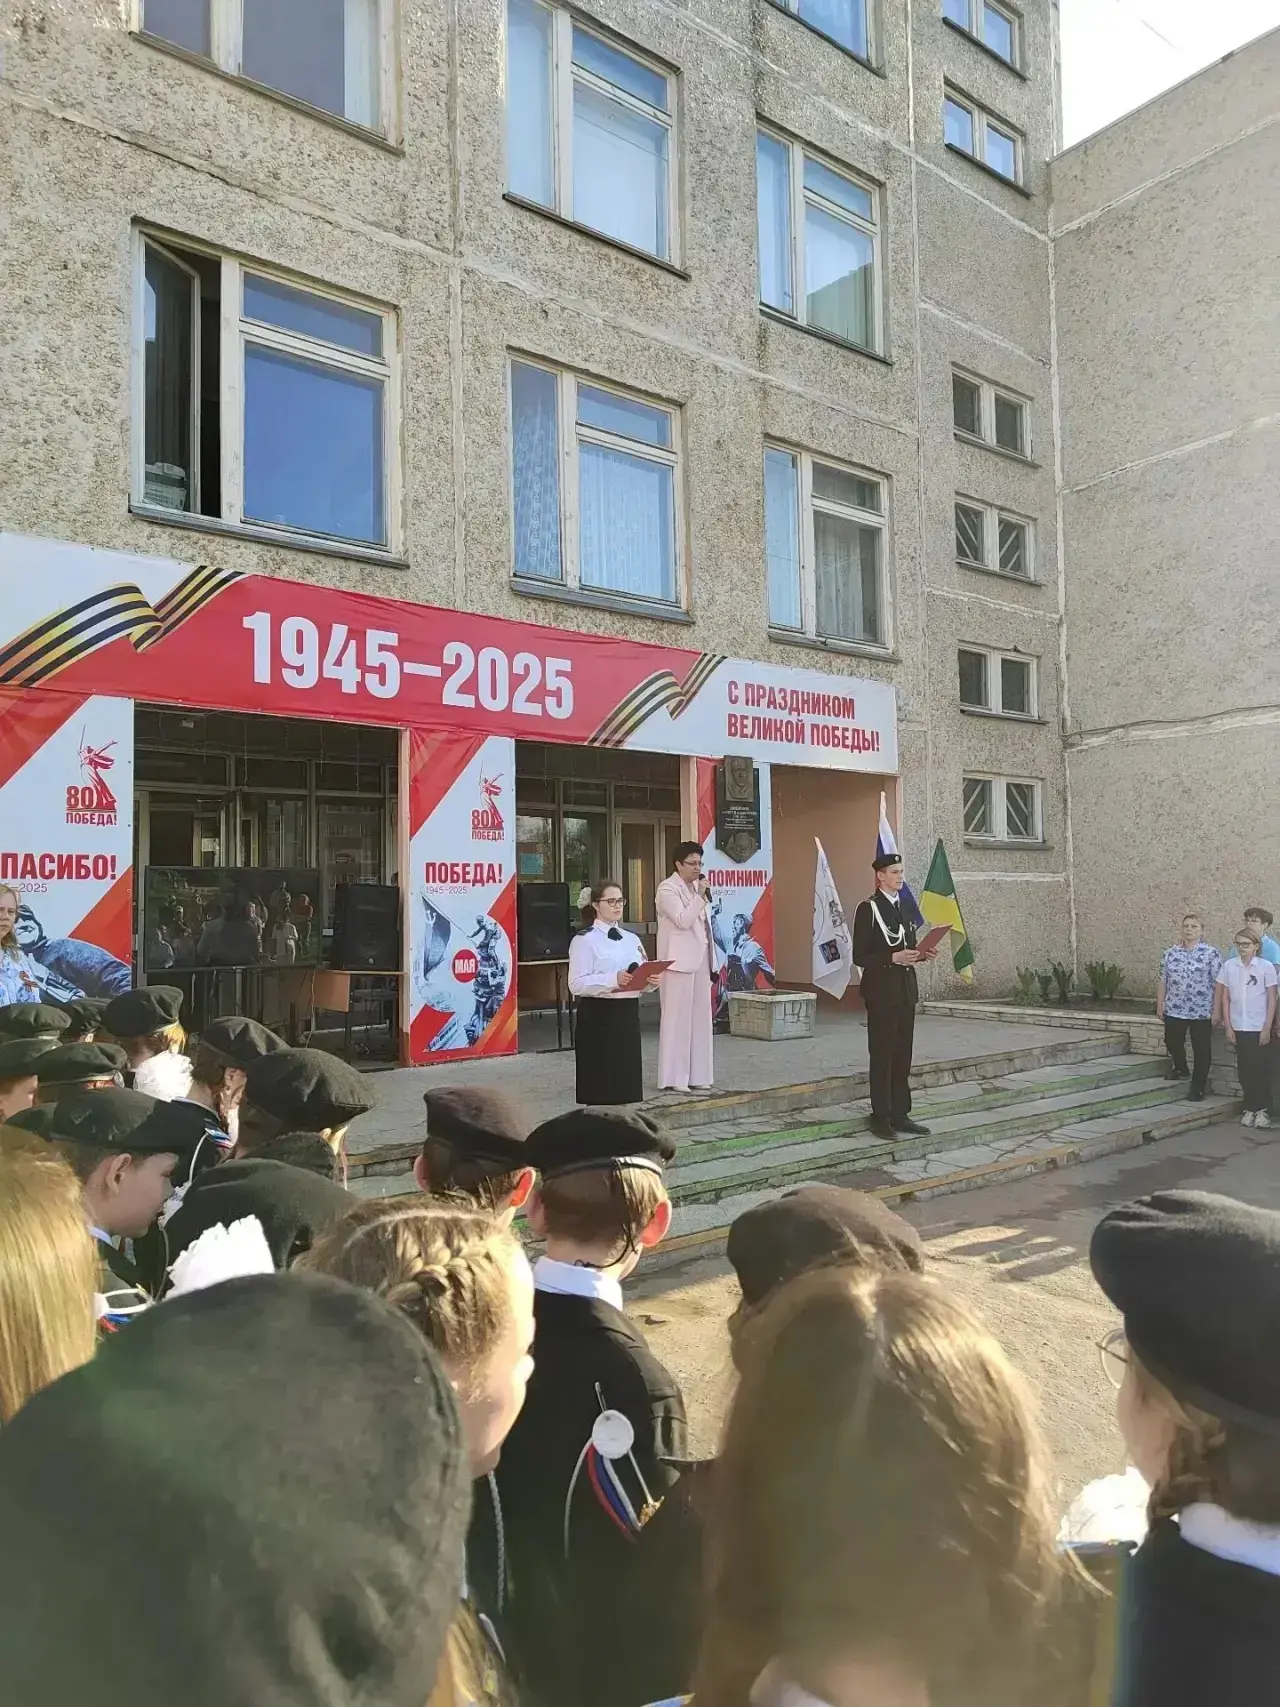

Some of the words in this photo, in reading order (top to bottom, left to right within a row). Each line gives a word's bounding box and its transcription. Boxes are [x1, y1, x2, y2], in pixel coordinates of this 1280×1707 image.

[727, 680, 739, 705] С
[744, 682, 856, 720] ПРАЗДНИКОМ
[727, 713, 806, 745] ВЕЛИКОЙ
[810, 723, 880, 754] ПОБЕДЫ!
[66, 785, 93, 809] 80
[65, 812, 118, 827] ПОБЕДА!
[471, 809, 490, 829] 80
[471, 829, 505, 842] ПОБЕДА!
[1, 852, 117, 880] ПАСИБО!
[425, 862, 503, 887] ПОБЕДА!
[708, 869, 768, 887] ПОМНИМ!
[454, 958, 476, 975] МАЯ
